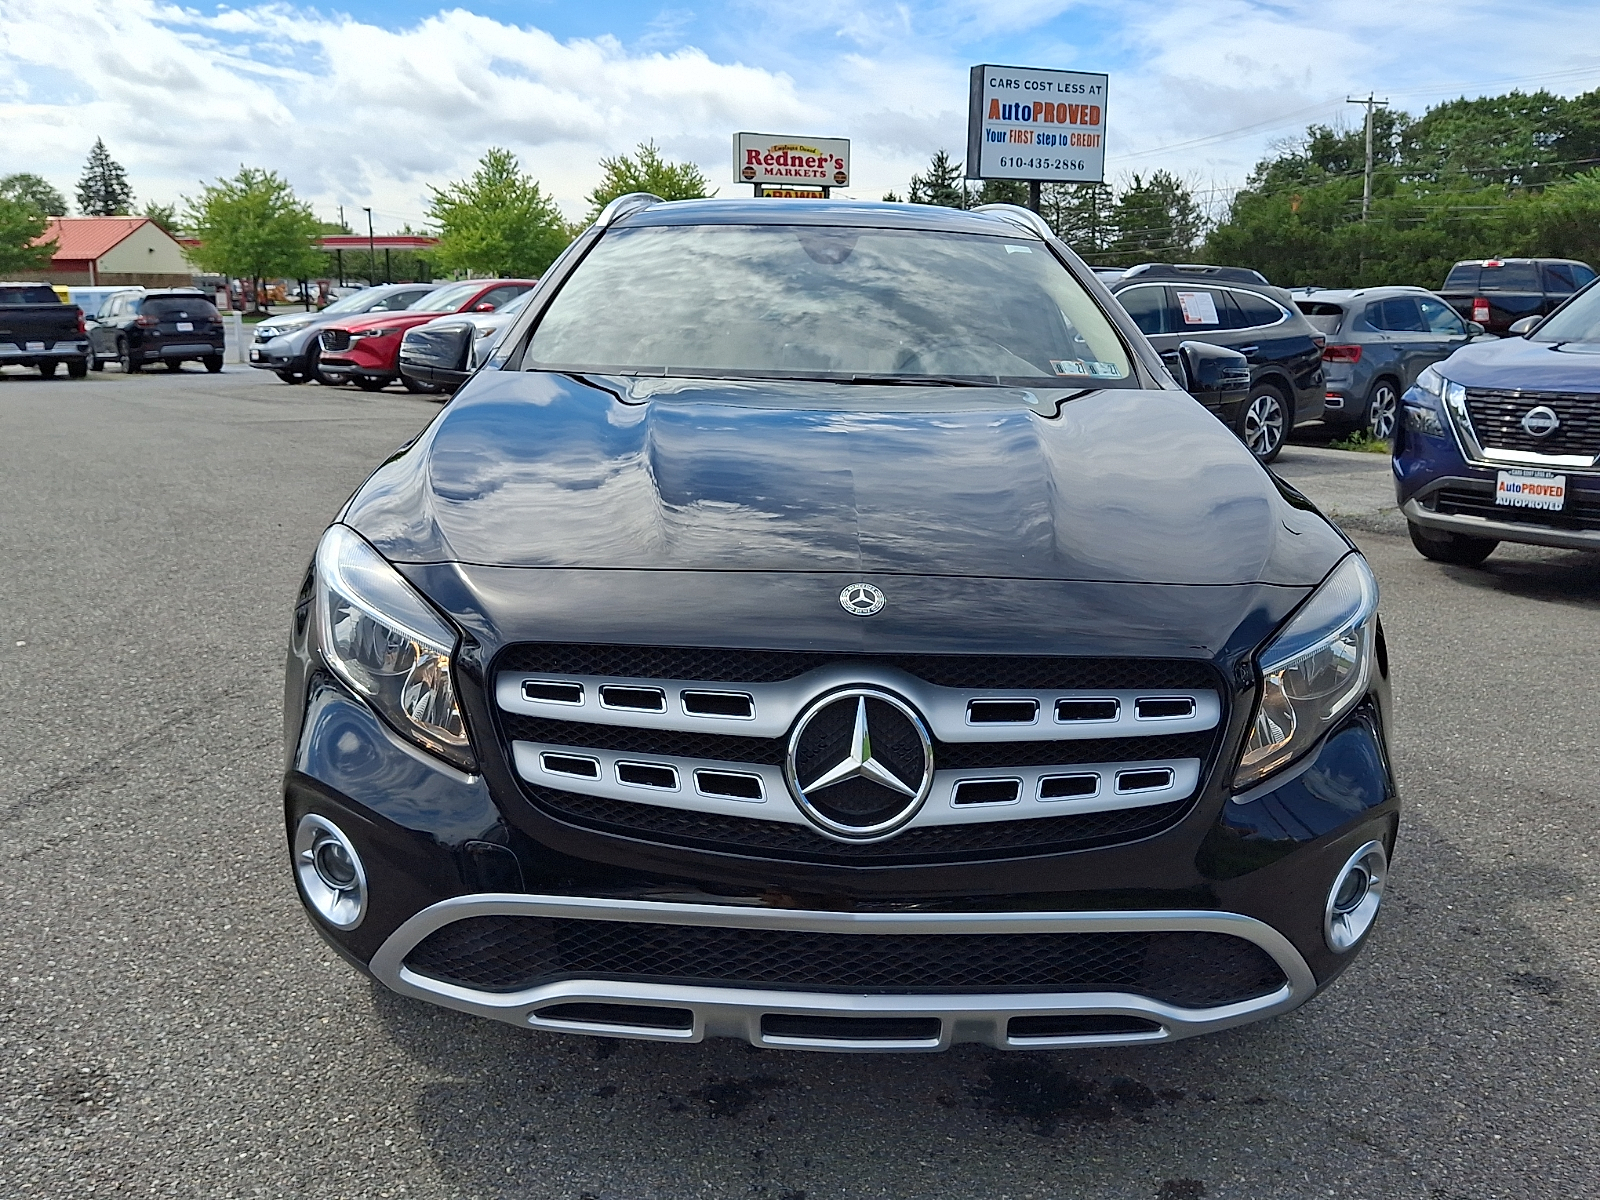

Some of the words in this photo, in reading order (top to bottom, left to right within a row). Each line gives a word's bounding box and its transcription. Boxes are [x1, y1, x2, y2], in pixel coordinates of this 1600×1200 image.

[990, 78, 1020, 89] CARS
[1024, 80, 1053, 92] COST
[1057, 83, 1085, 94] LESS
[1089, 85, 1102, 95] AT
[988, 98, 1101, 126] AutoPROVED
[986, 128, 1007, 143] Your
[1009, 129, 1034, 144] FIRST
[1036, 132, 1057, 147] step
[1058, 133, 1068, 147] to
[1070, 132, 1101, 148] CREDIT
[746, 149, 844, 170] Redner's
[1000, 156, 1085, 171] 610-435-2886
[764, 167, 826, 178] MARKETS
[1499, 481, 1563, 497] AutoPROVED
[1495, 497, 1563, 511] AUTOPROVED
